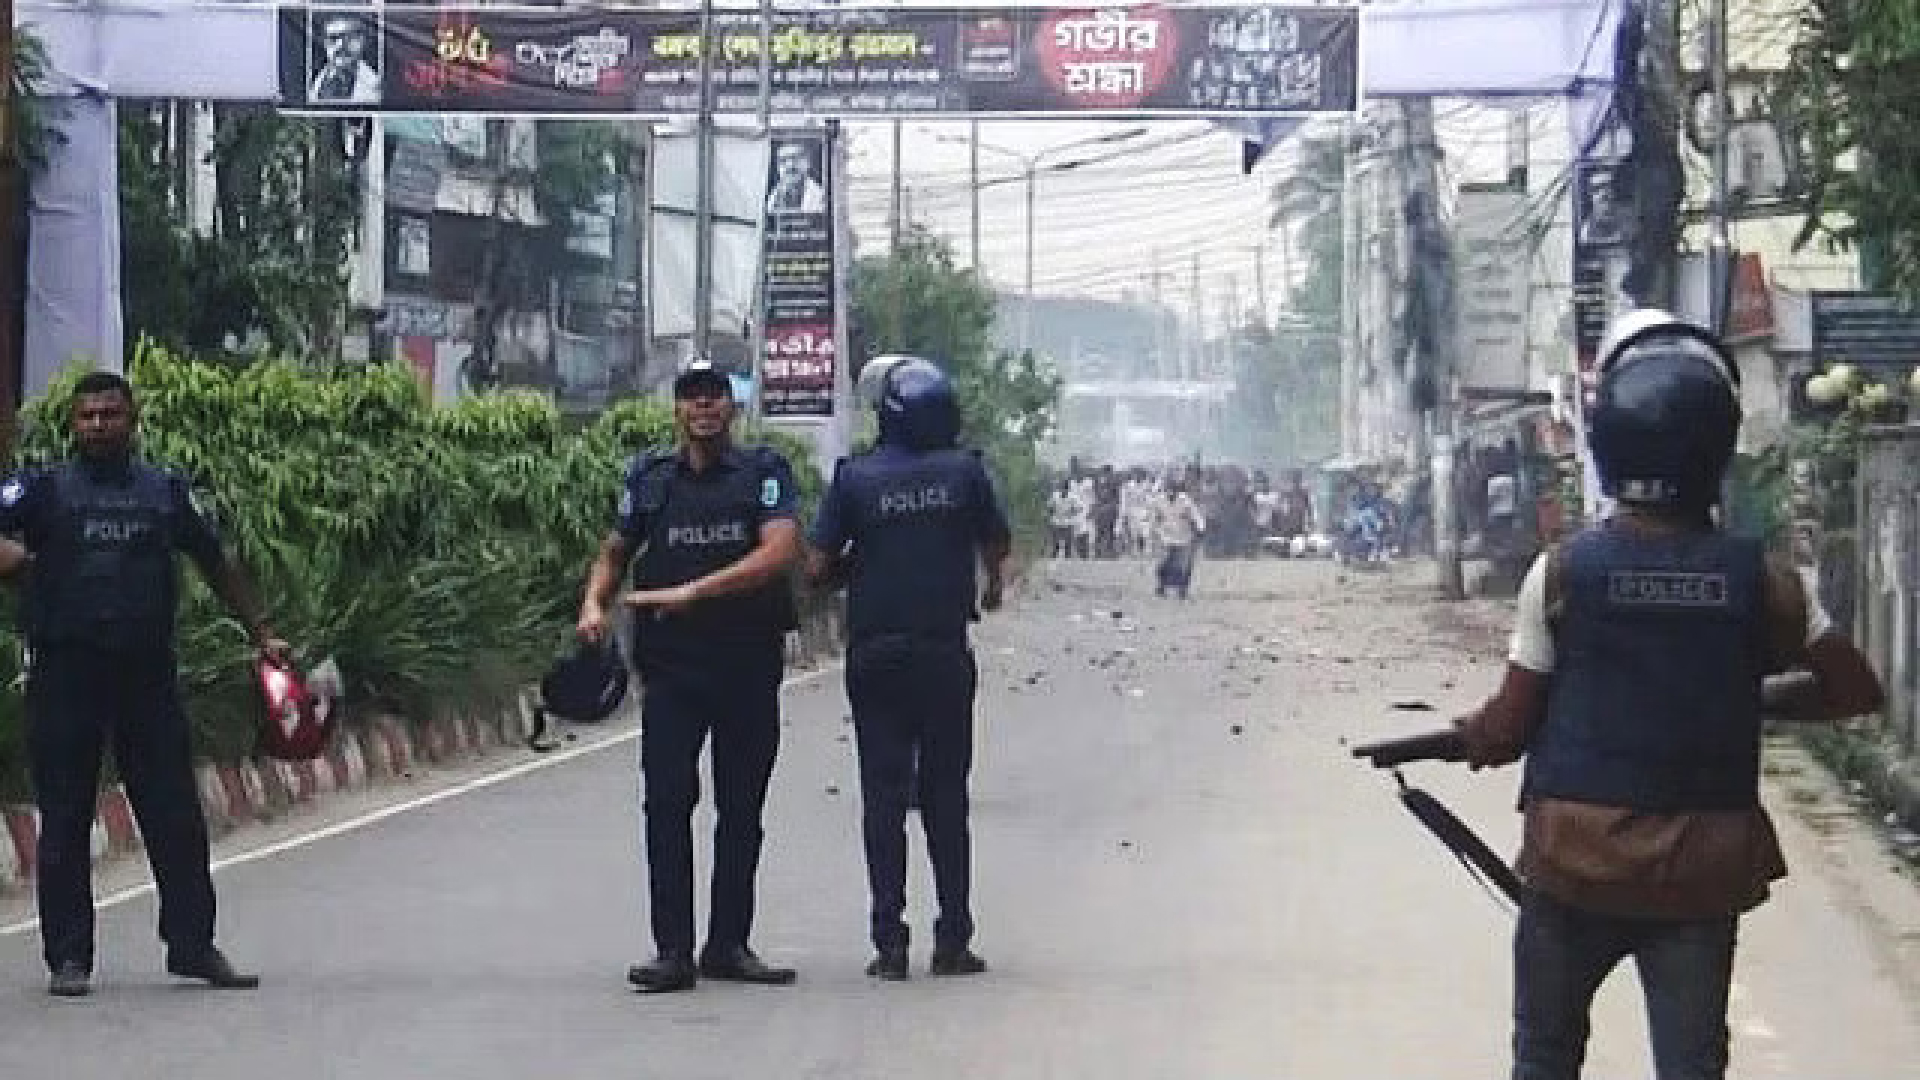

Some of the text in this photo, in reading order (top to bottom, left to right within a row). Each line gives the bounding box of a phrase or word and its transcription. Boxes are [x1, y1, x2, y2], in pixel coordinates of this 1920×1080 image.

[1055, 11, 1158, 51] গভীর
[880, 485, 957, 512] POLICE
[668, 523, 744, 546] POLICE
[1617, 576, 1718, 600] POLICE
